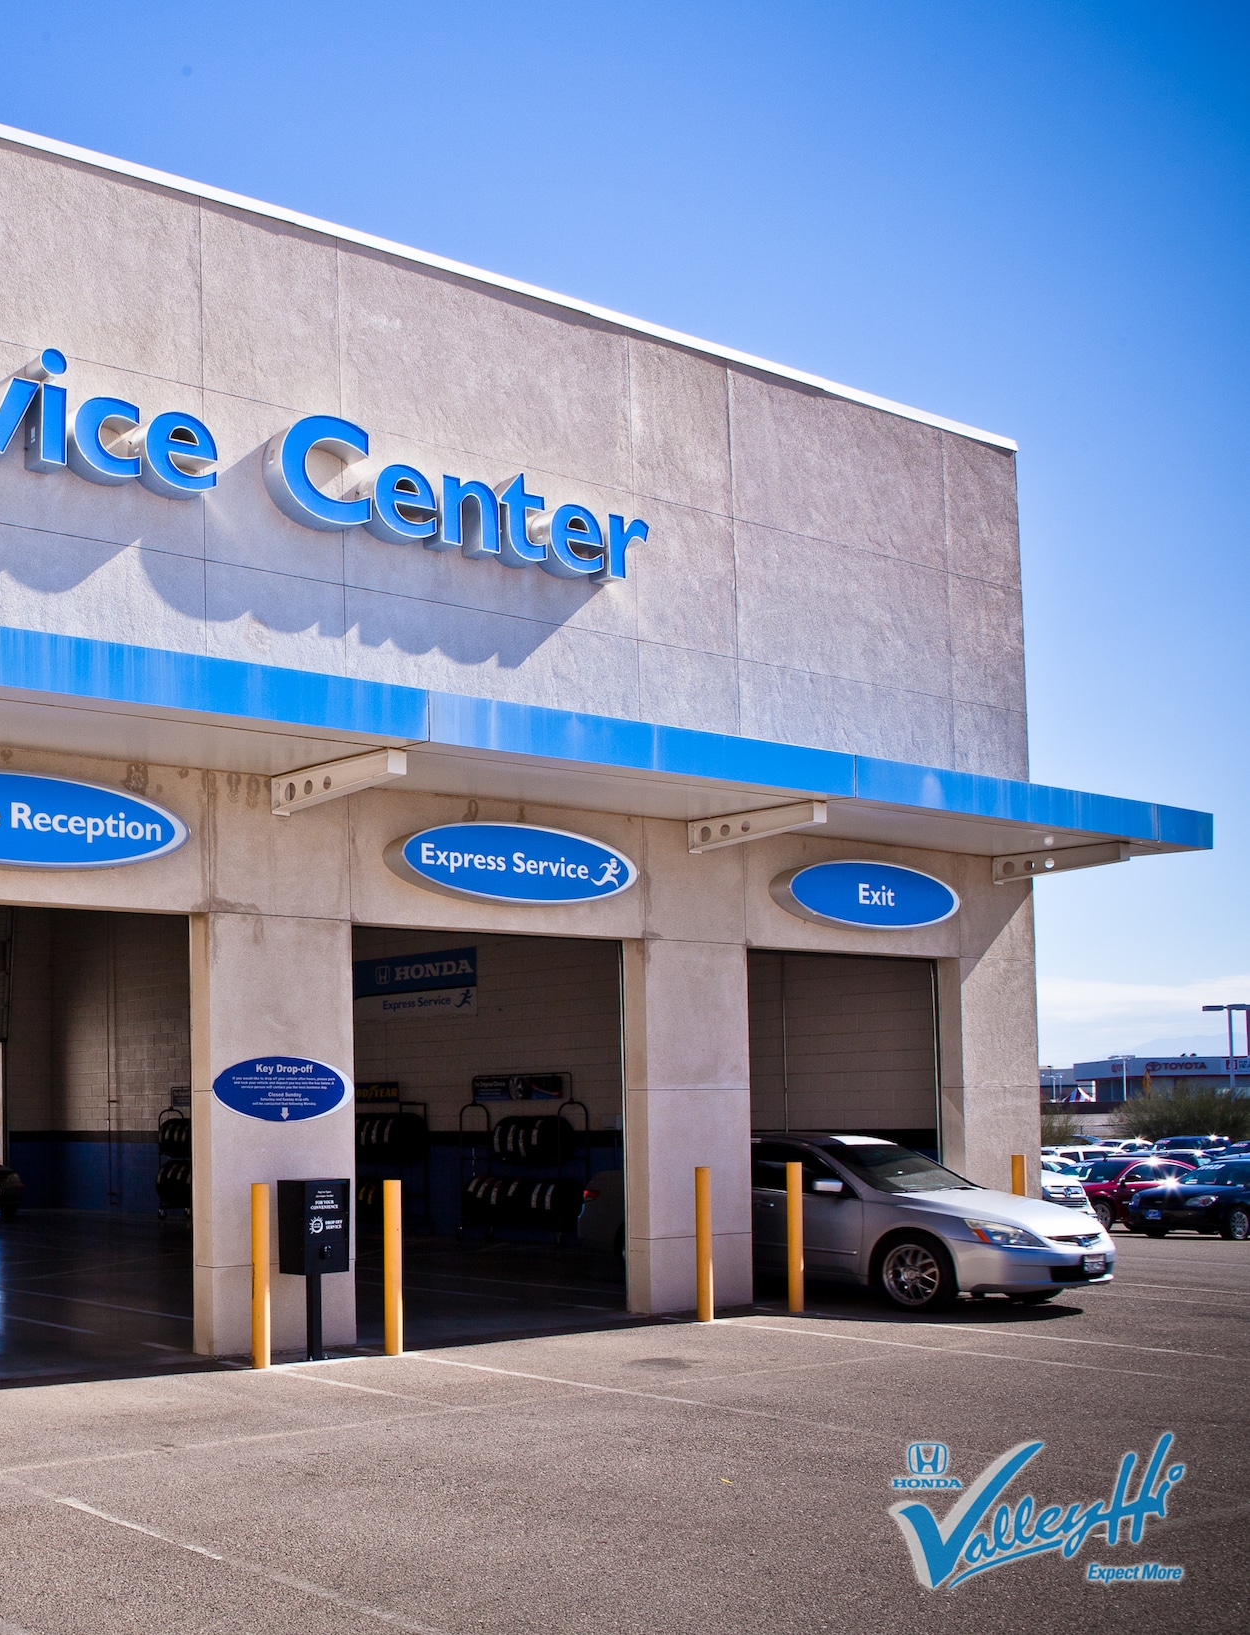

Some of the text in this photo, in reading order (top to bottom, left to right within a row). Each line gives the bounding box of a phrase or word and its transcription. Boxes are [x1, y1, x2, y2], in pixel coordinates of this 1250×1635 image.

[268, 414, 648, 583] Center
[10, 801, 162, 844] Reception
[420, 842, 590, 880] Express Service
[858, 883, 896, 907] Exit
[394, 959, 474, 982] HONDA
[383, 997, 452, 1011] Express Service
[255, 1063, 314, 1075] Key Drop-off
[1162, 1061, 1208, 1071] TOYOTA
[356, 1084, 398, 1101] ODYEAR
